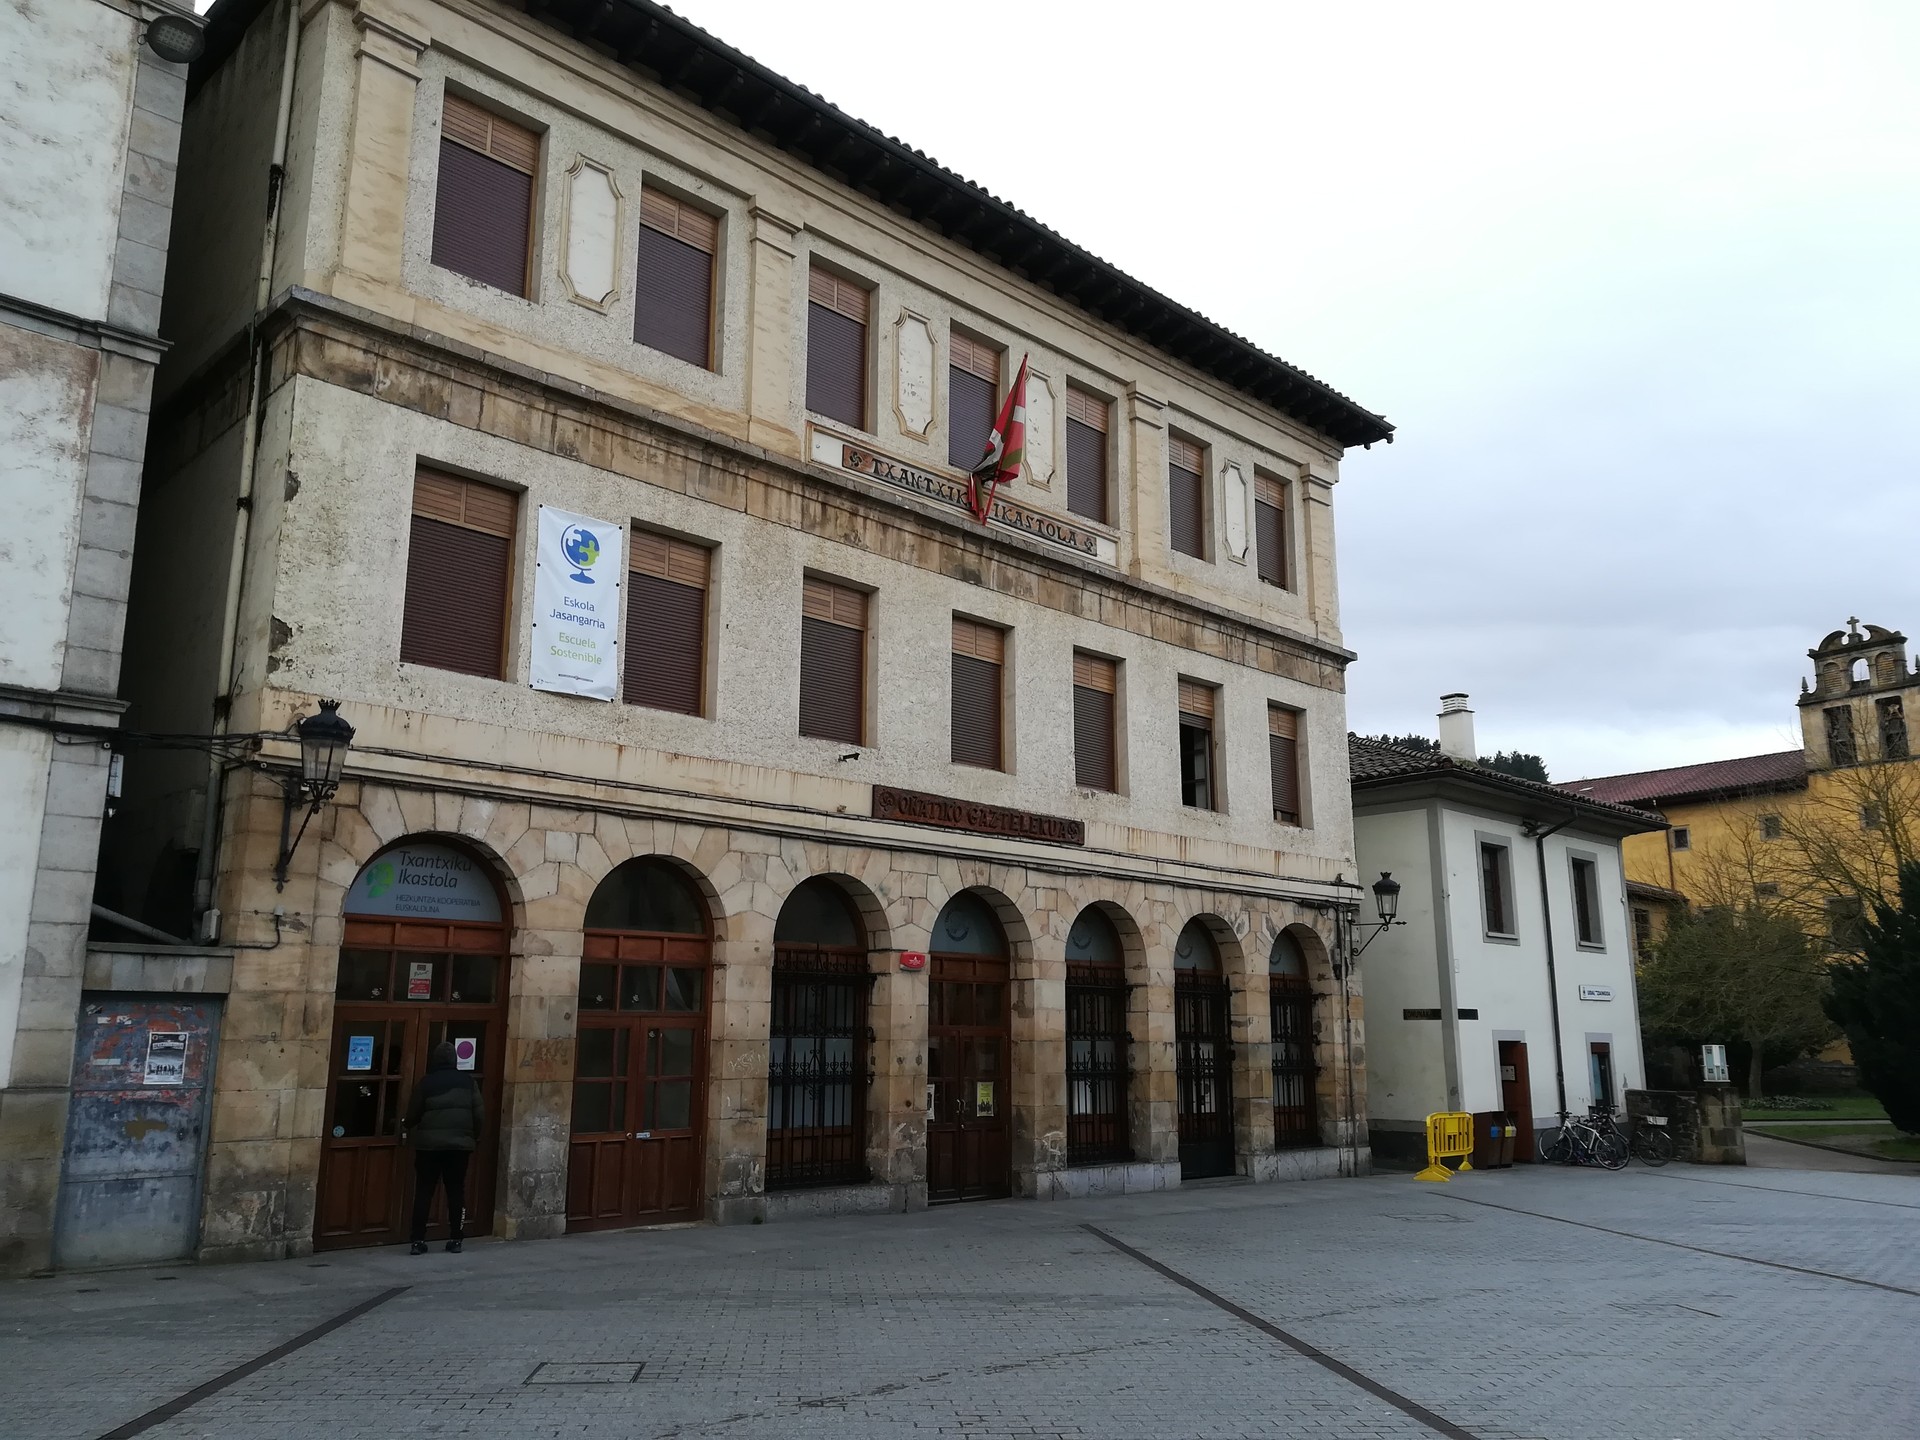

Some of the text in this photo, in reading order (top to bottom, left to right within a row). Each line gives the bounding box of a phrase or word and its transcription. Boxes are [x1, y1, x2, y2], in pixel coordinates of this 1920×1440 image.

[872, 457, 1078, 545] TXANTXIK IKASTOLA
[563, 596, 594, 611] Eskola
[549, 608, 605, 629] Jasangarria
[559, 632, 596, 649] Escuela
[550, 645, 602, 664] Sostenible
[897, 796, 1067, 839] OÑATIKO GAZTELEKUA
[399, 850, 472, 873] Txantxiku
[397, 868, 458, 889] Ikastola
[395, 903, 440, 913] EUSKALDUNA
[396, 894, 436, 904] HEZKUNTZA
